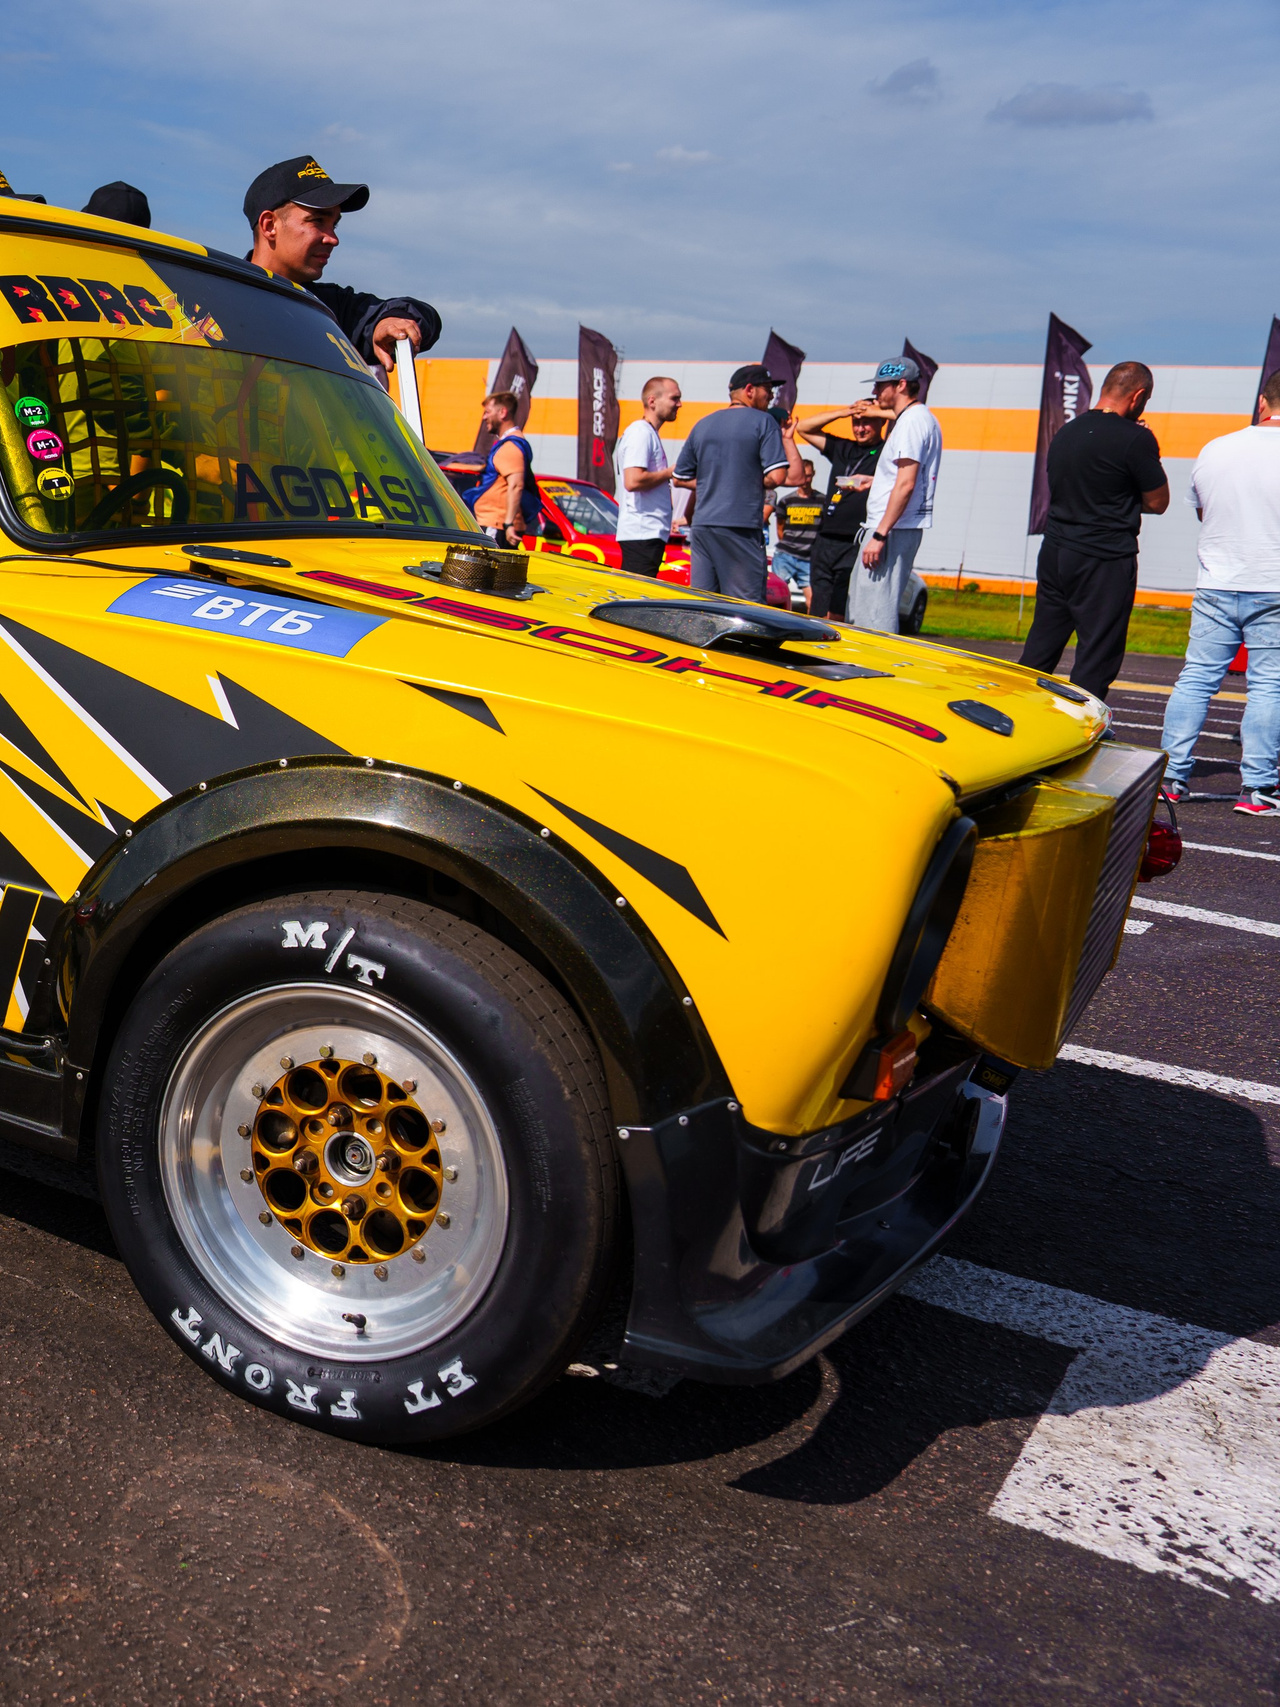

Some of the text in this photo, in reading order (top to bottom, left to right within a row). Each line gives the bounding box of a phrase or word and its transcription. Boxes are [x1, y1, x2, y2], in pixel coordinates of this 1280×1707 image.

[326, 332, 373, 377] 11
[23, 407, 42, 417] M-2
[36, 440, 55, 450] M-1
[52, 479, 59, 487] T
[236, 463, 446, 526] AGDASH
[192, 594, 324, 639] ВТБ
[280, 921, 386, 986] M/T
[807, 1128, 882, 1191] LIFE
[172, 1306, 478, 1420] ET FRONT
